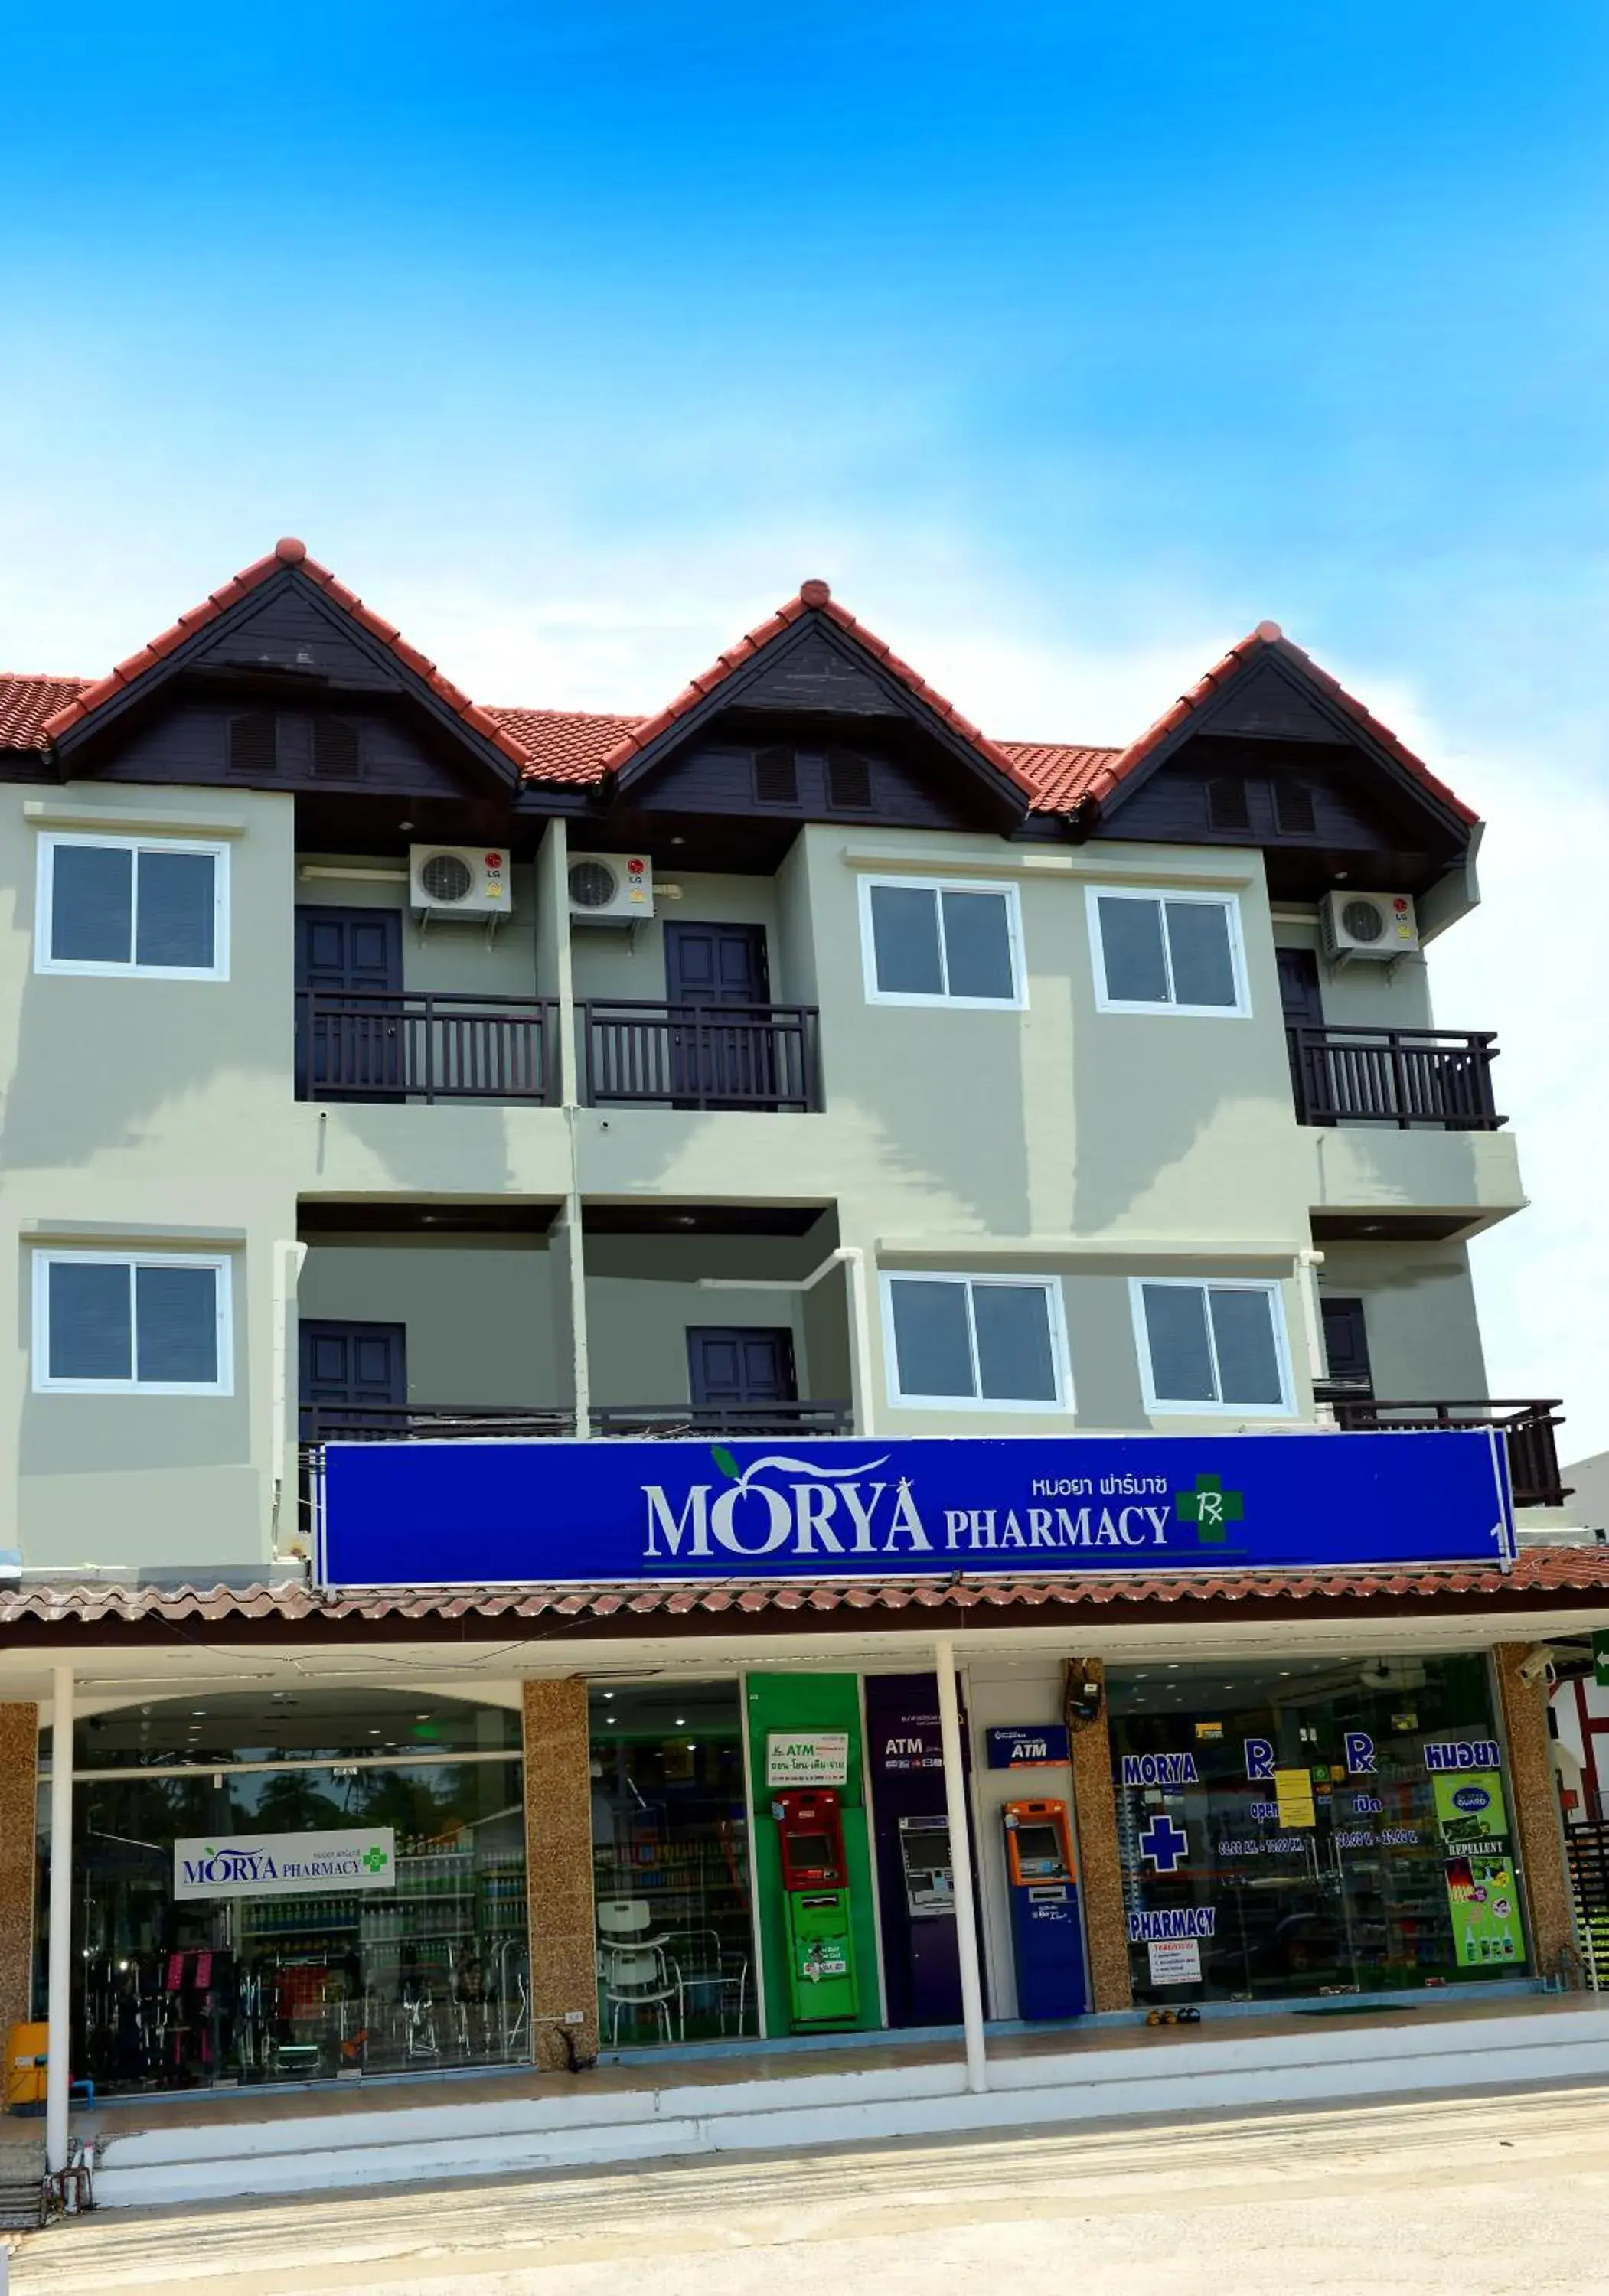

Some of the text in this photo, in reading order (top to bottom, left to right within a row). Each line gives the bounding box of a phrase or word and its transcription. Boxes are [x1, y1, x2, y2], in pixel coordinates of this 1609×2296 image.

[640, 1477, 1171, 1556] MORYA PHARMACY
[786, 1744, 814, 1756] ATM
[886, 1738, 923, 1755] ATM
[1011, 1743, 1047, 1758] ATM
[1121, 1753, 1199, 1786] MORYA
[1449, 1841, 1503, 1856] REPELLENT
[183, 1856, 279, 1885] MORYA
[283, 1861, 363, 1878] PHARMACY
[1129, 1906, 1216, 1942] PHARMACY
